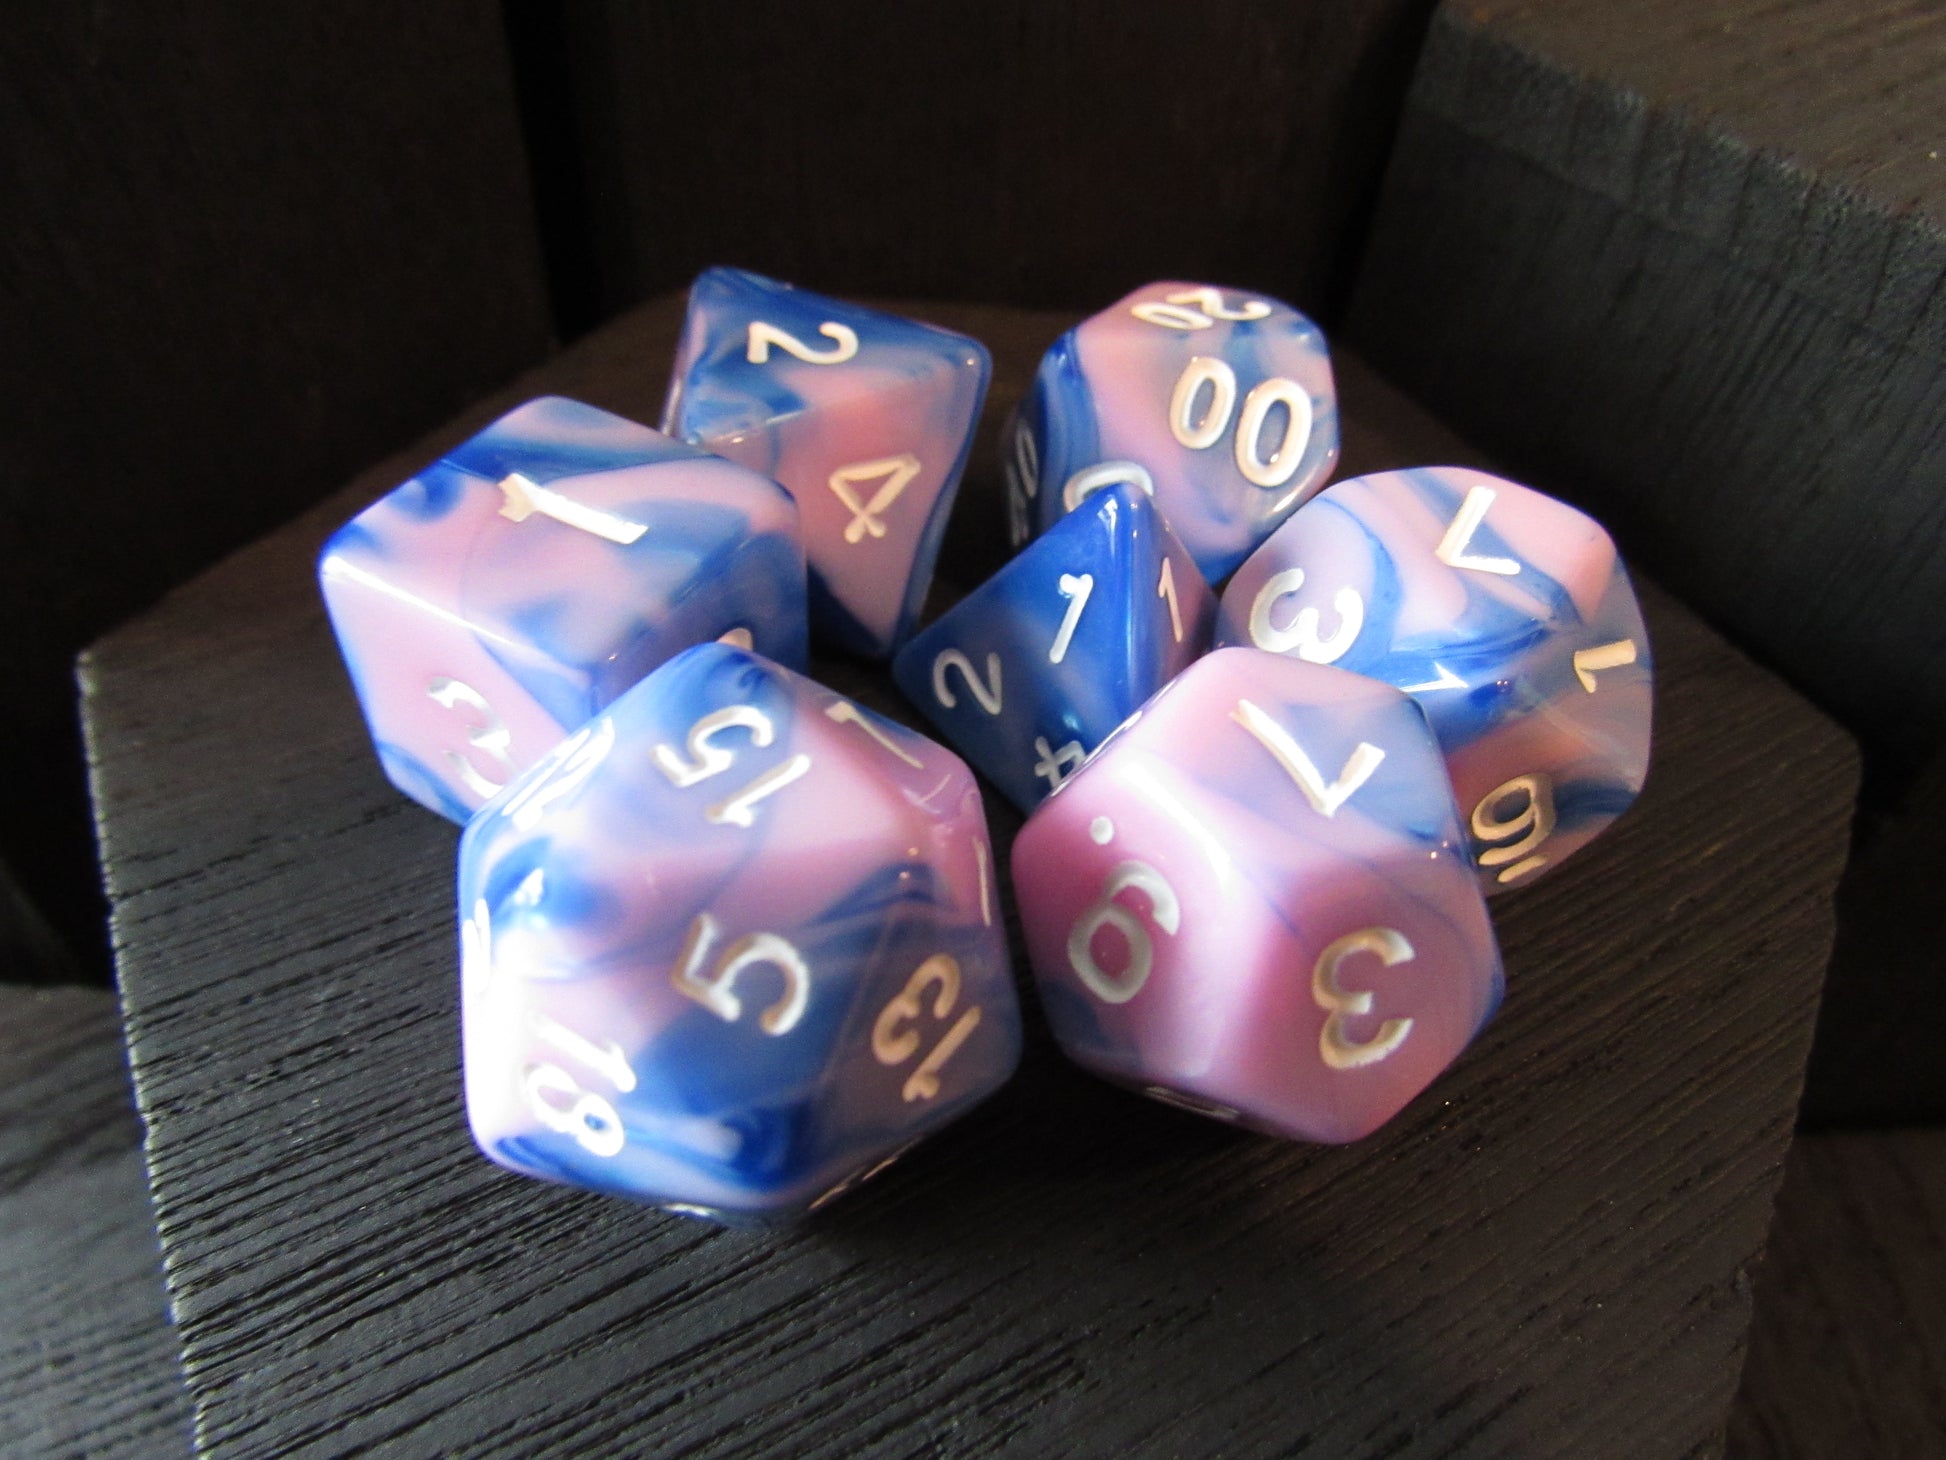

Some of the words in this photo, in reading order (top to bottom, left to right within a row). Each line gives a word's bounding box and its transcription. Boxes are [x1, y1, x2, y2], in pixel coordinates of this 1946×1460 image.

[747, 321, 858, 365] 2
[1169, 357, 1312, 487] 00
[498, 473, 648, 545] 1
[829, 454, 921, 543] 4
[1435, 486, 1520, 574] 7
[1050, 573, 1093, 663] 1
[1158, 557, 1183, 642] 1
[1249, 568, 1364, 664] 3
[933, 648, 1001, 716] 2
[650, 705, 812, 827] 15
[1229, 699, 1385, 818] 7
[670, 912, 811, 1037] 5
[1312, 927, 1415, 1069] 3
[871, 953, 980, 1102] 13
[521, 1008, 637, 1157] 18
